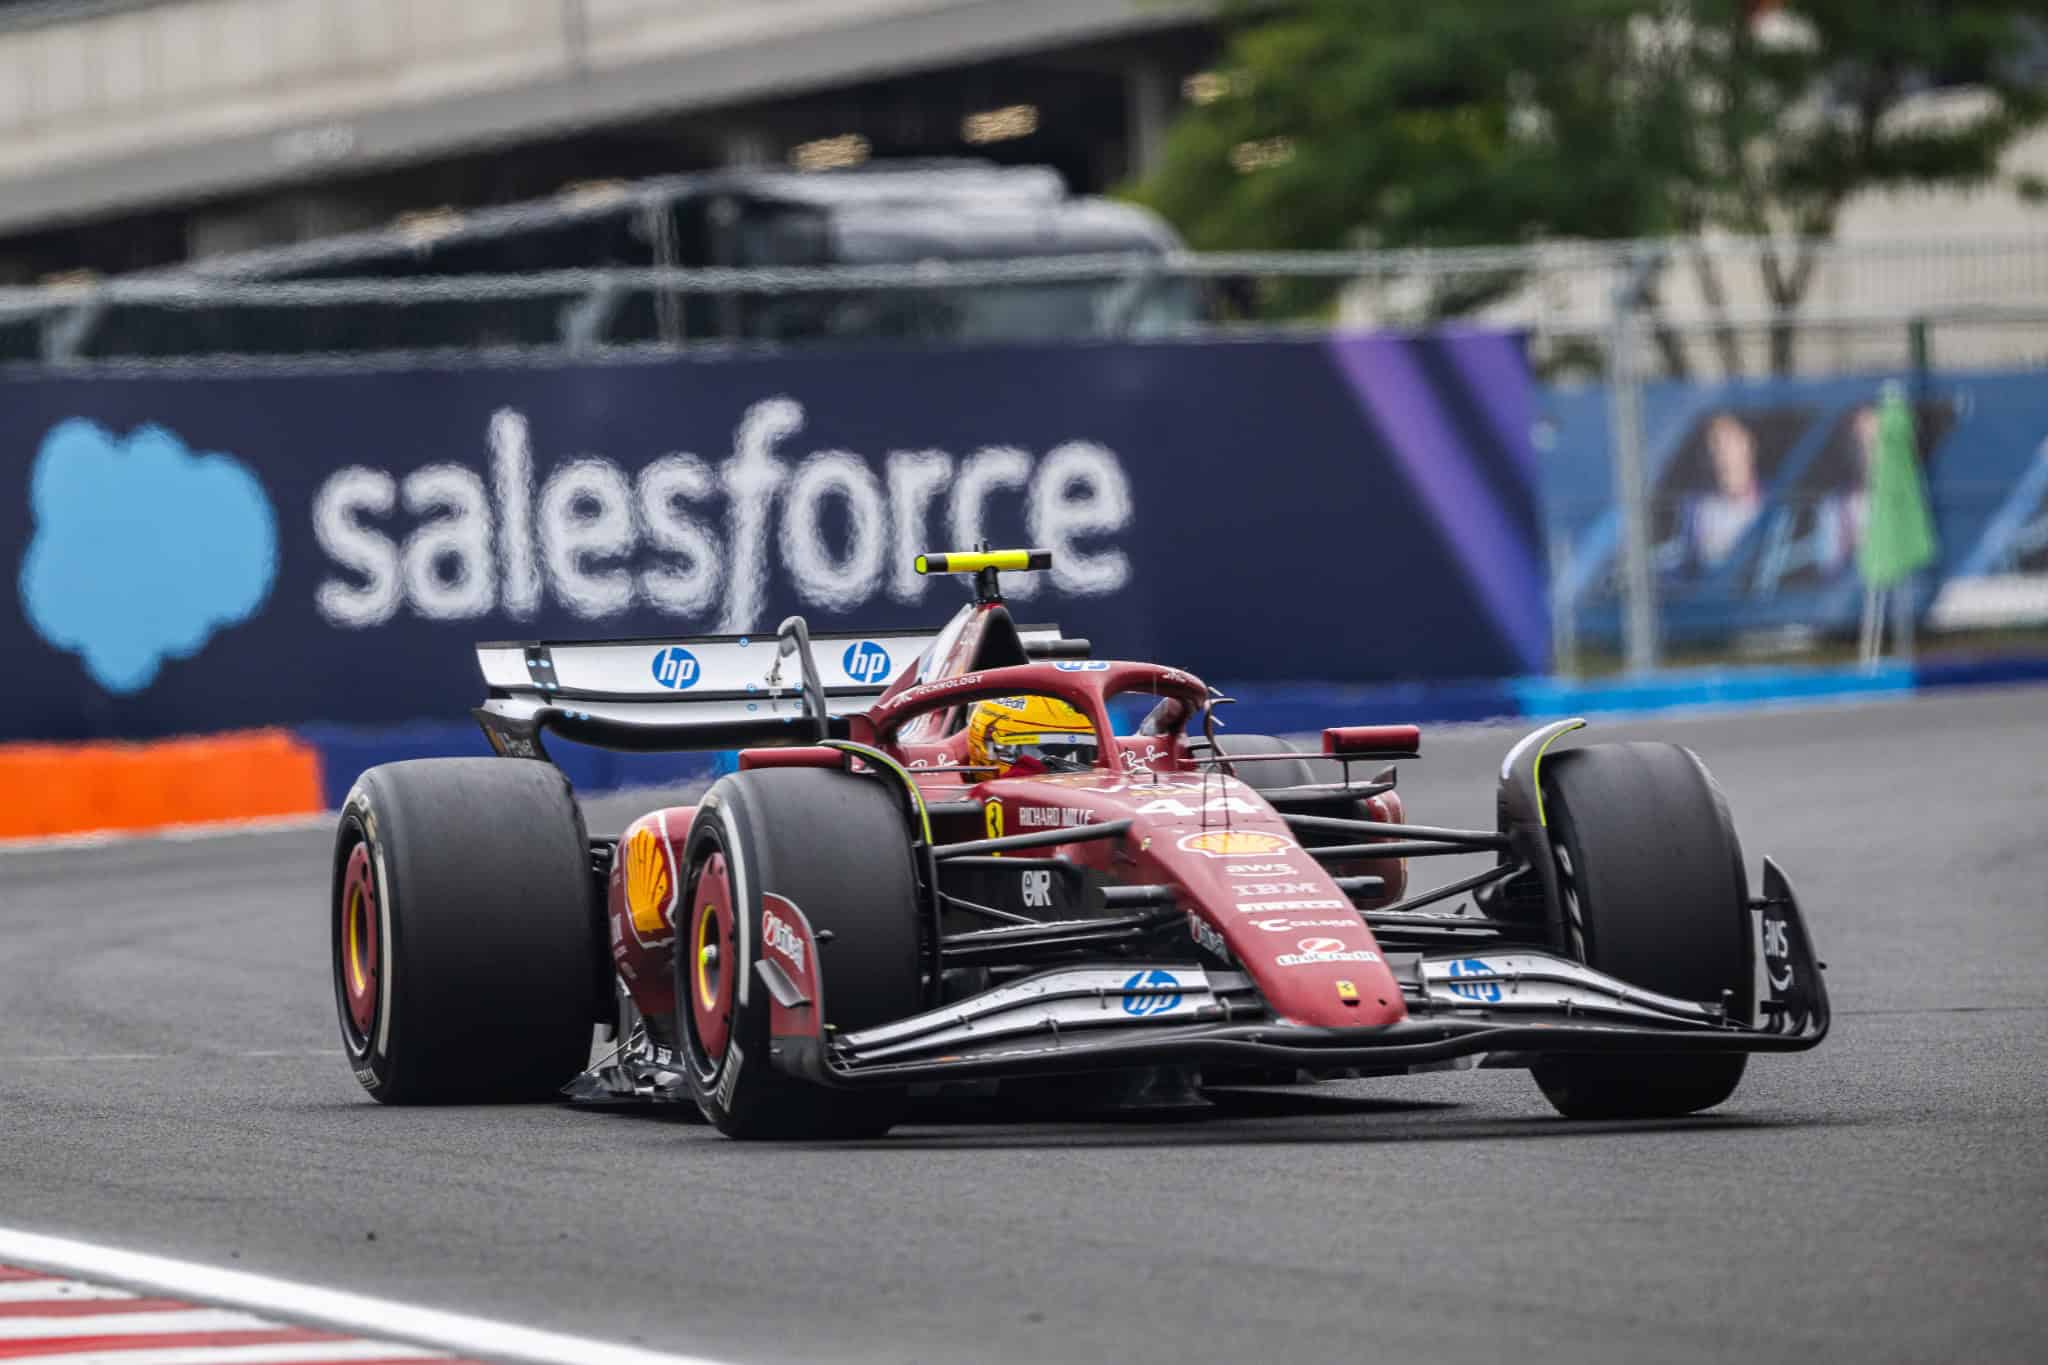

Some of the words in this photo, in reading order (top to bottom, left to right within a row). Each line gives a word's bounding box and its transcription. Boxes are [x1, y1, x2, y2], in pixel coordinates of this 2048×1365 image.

[313, 396, 1131, 633] salesforce
[658, 647, 696, 690] hp
[849, 641, 887, 683] hp
[1019, 807, 1060, 826] RICHARD
[1231, 882, 1320, 896] IBM
[1127, 969, 1177, 1016] hp
